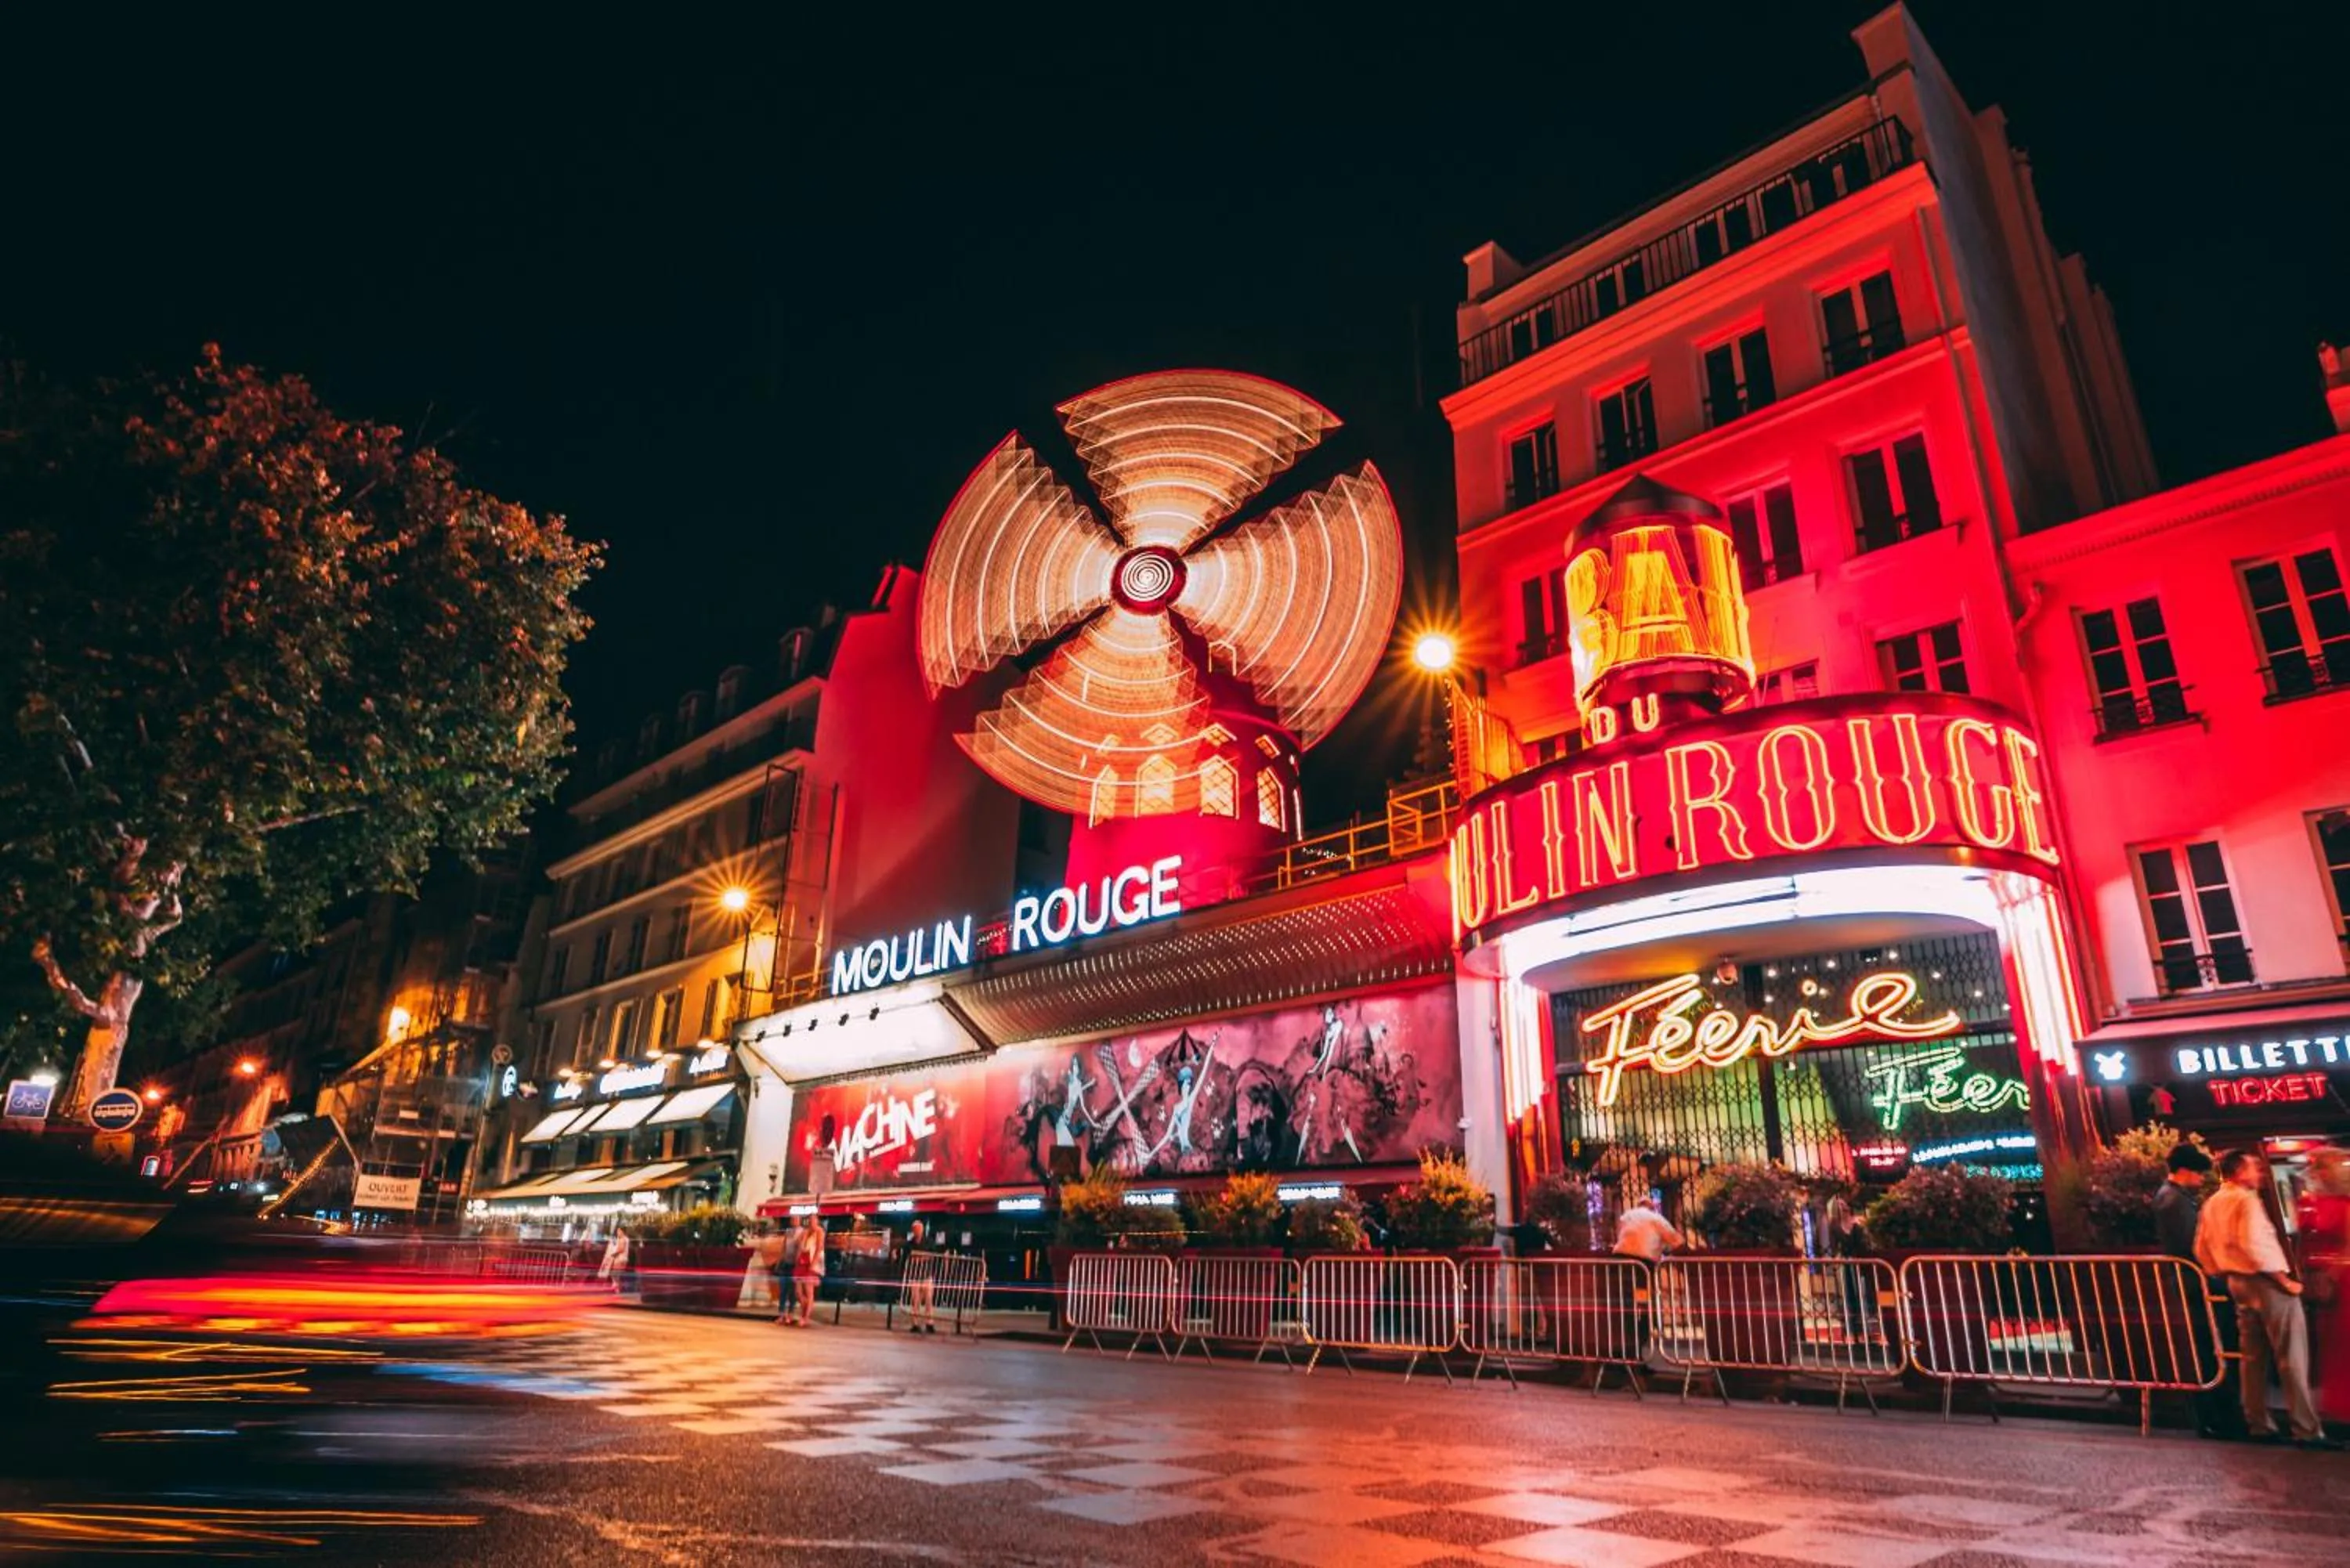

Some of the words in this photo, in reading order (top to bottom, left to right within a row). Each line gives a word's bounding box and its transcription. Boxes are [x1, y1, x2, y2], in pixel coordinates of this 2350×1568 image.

[1589, 692, 1660, 745] DU
[1450, 761, 1637, 944] ULIN
[1665, 714, 2060, 871] ROUGE
[830, 914, 972, 996] MOULIN
[1012, 854, 1183, 952] ROUGE
[1582, 972, 1961, 1107] Féerie
[2177, 1032, 2350, 1075] BILLETT
[2207, 1070, 2328, 1107] TICKET
